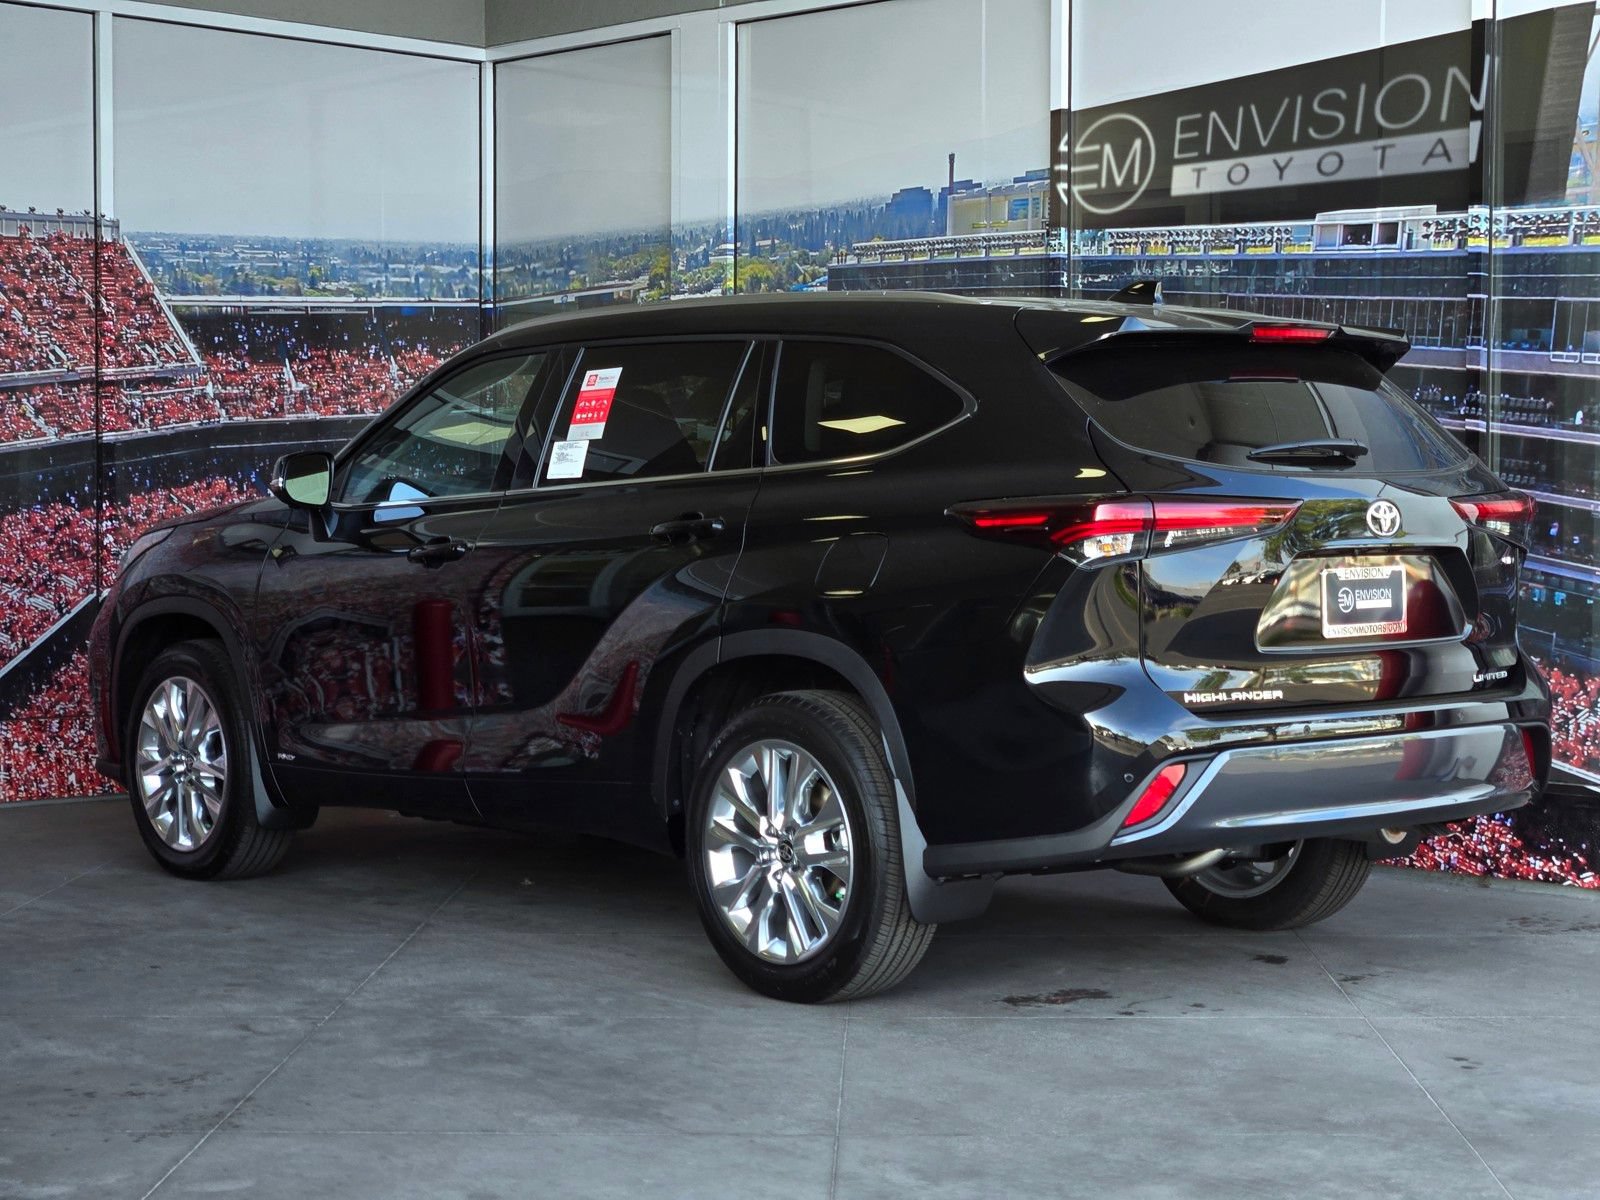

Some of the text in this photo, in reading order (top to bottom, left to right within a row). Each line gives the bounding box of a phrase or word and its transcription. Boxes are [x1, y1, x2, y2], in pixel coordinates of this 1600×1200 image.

[1173, 54, 1490, 159] ENVISION
[1191, 137, 1453, 188] TOYOTA
[1344, 567, 1384, 580] ENVISION
[1354, 588, 1392, 601] ENVISION
[1327, 622, 1406, 636] ENVISIONMOTORSCOM
[1472, 670, 1508, 683] LIMITED
[1183, 689, 1284, 704] HIGHLANDER
